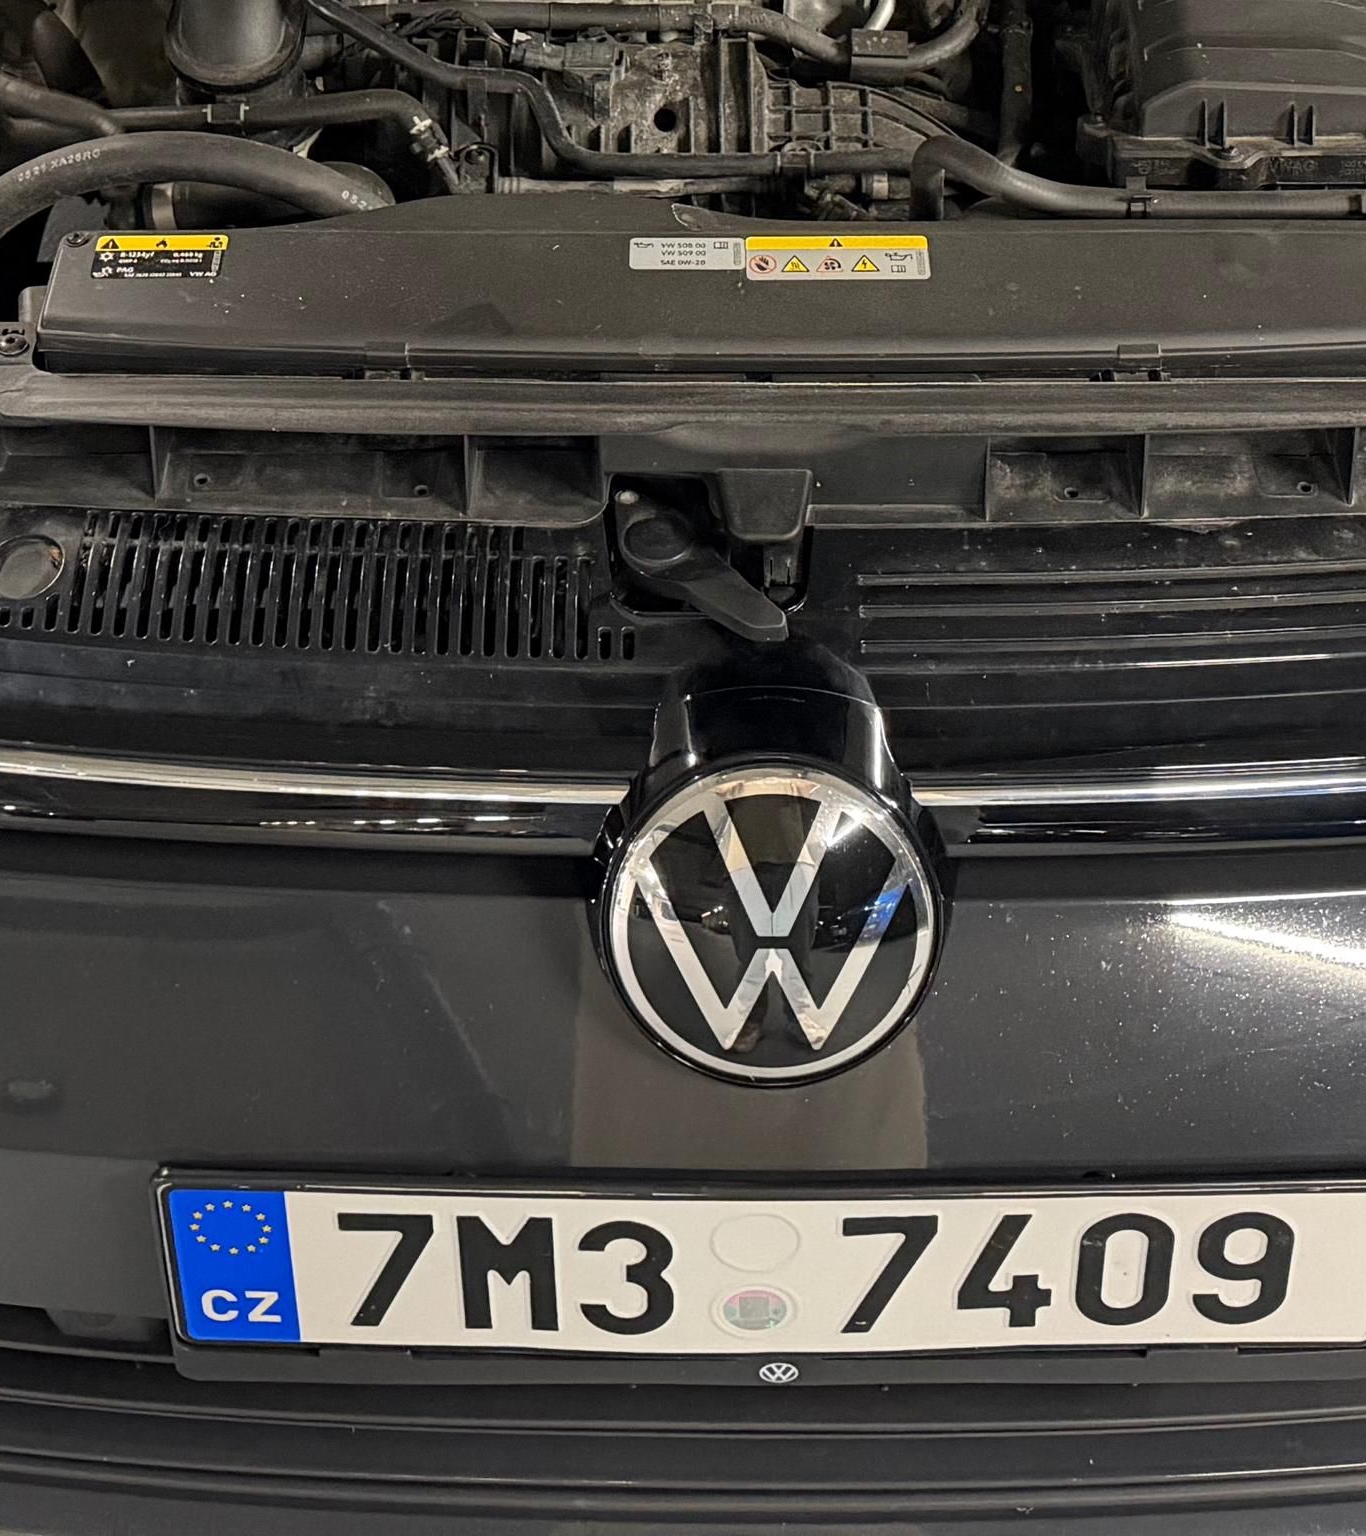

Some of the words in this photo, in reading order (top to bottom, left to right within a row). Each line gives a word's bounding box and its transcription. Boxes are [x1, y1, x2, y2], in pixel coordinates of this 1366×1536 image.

[612, 768, 934, 1080] VW
[202, 1290, 281, 1322] CZ
[336, 1212, 674, 1336] 7M3
[841, 1212, 1294, 1333] 7409
